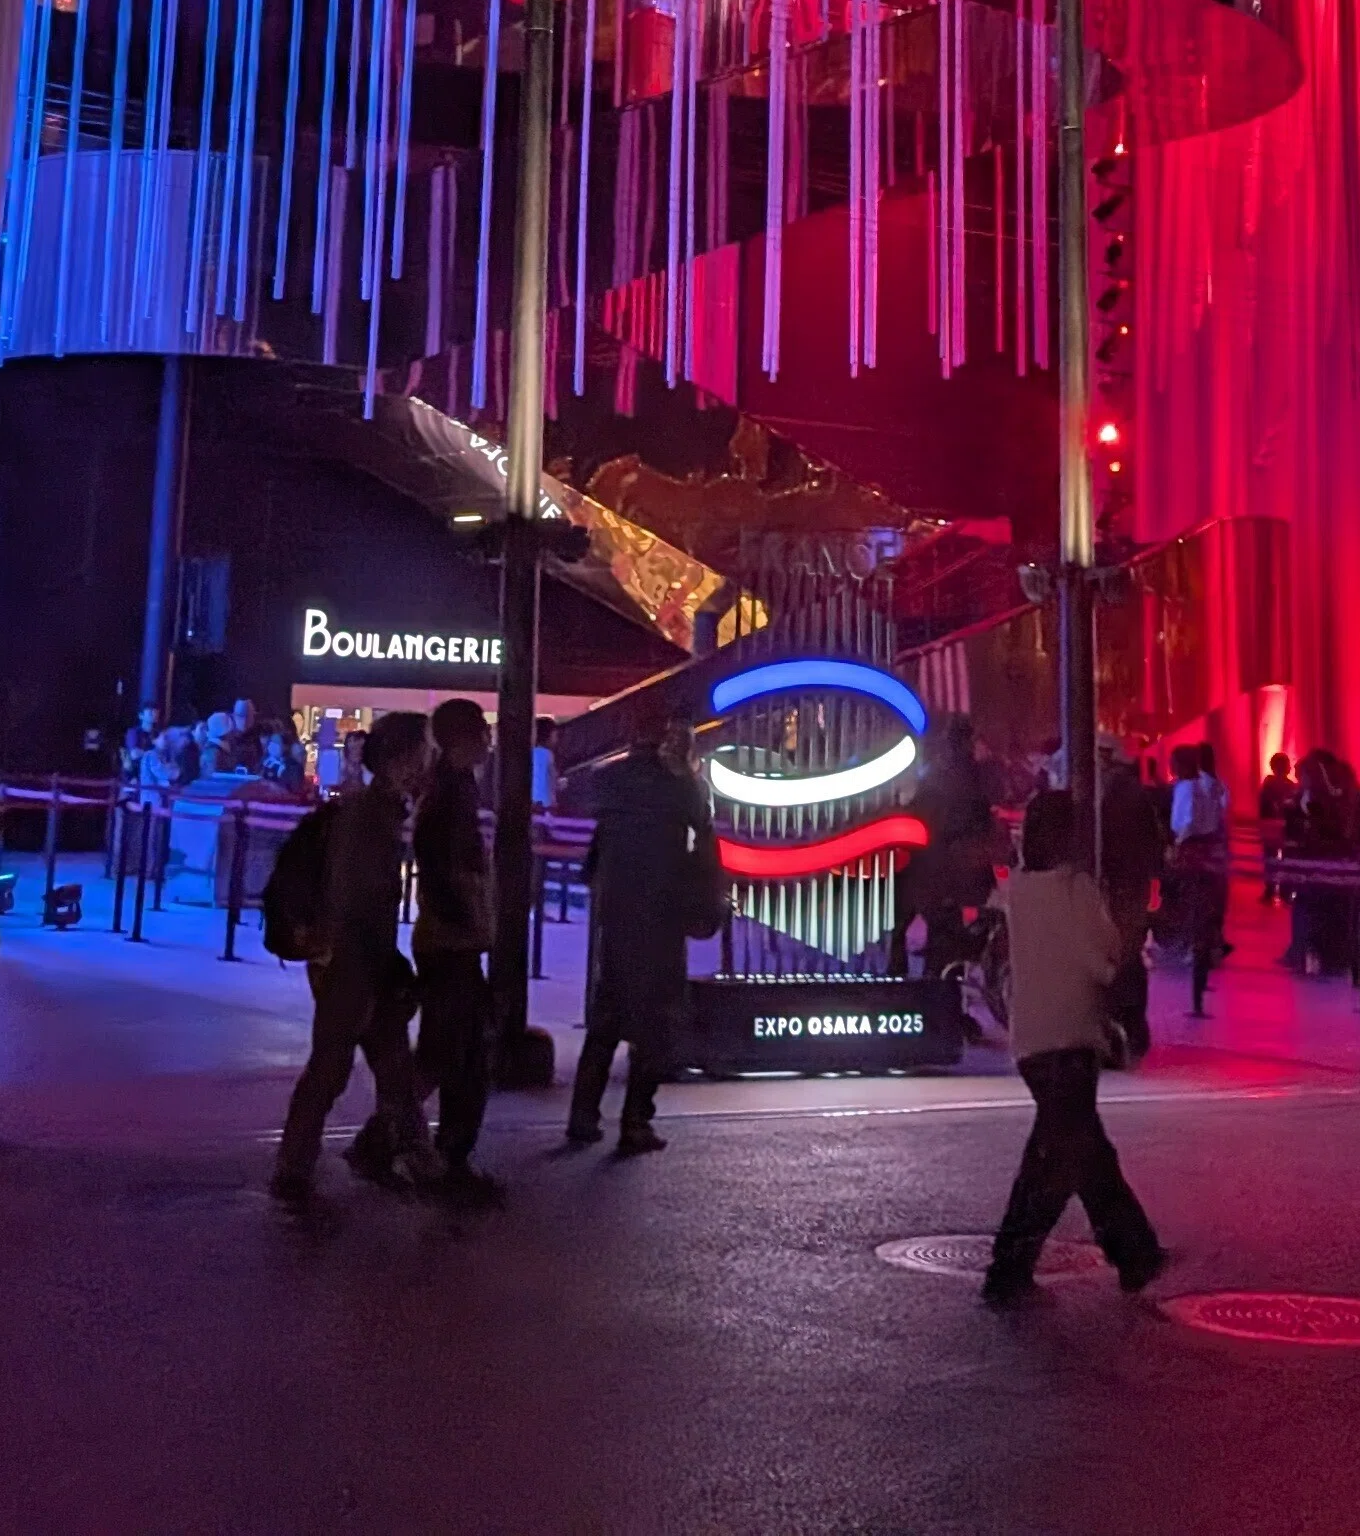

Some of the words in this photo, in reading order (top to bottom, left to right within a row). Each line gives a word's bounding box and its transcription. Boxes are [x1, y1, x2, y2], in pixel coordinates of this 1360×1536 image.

[303, 608, 502, 664] BOULANGERIE
[754, 1016, 802, 1037] EXPO
[808, 1015, 873, 1036] OSAKA
[877, 1014, 925, 1035] 2025
